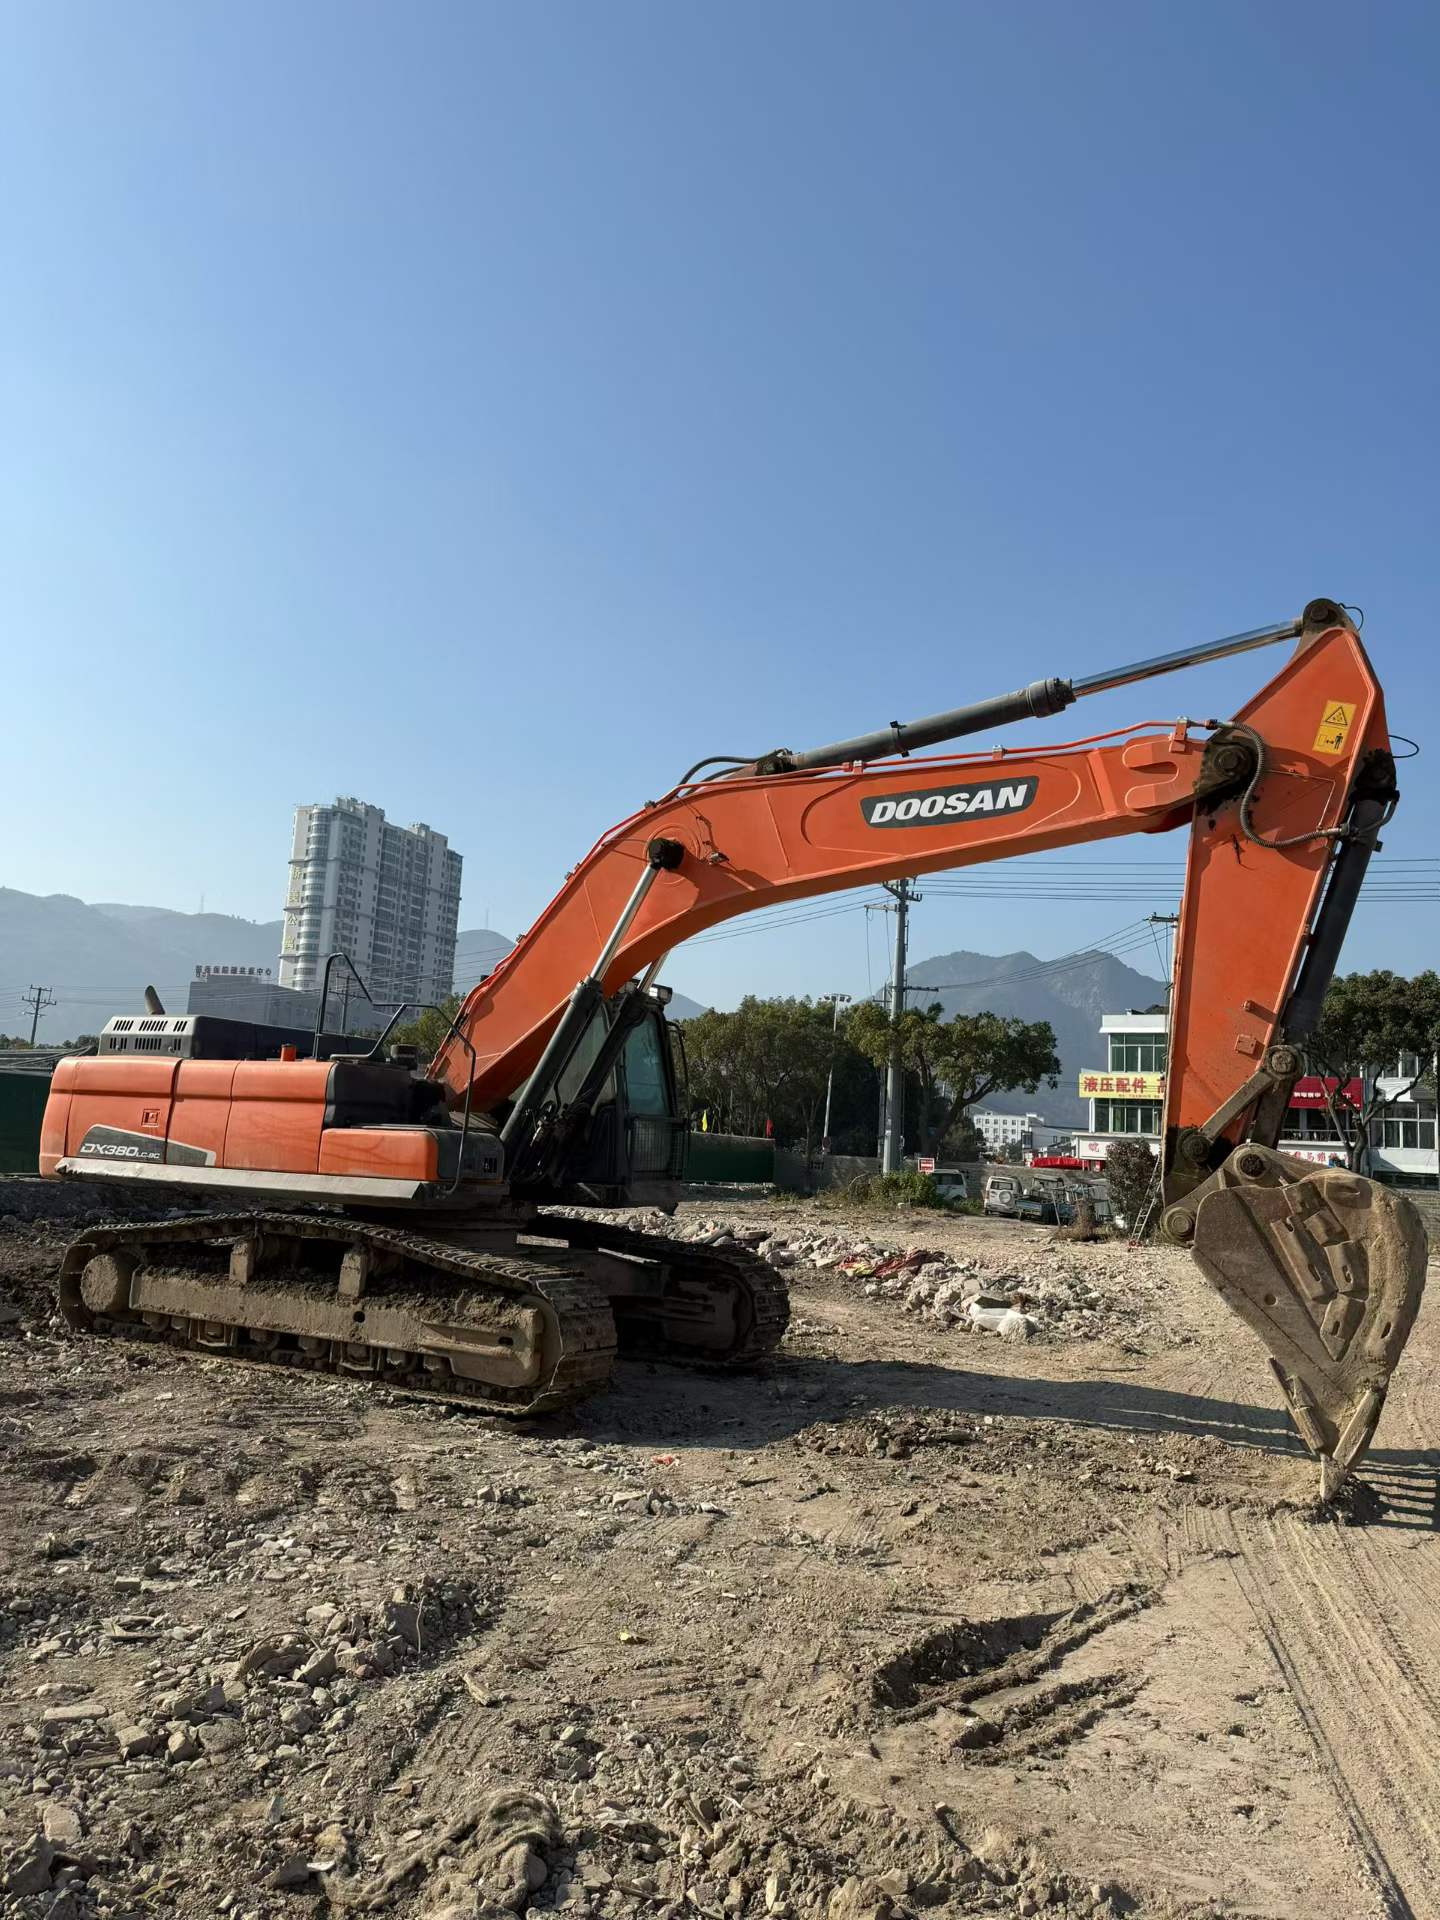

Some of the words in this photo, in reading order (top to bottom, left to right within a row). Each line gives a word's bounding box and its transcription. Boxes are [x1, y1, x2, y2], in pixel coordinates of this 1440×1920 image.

[870, 784, 1028, 824] DOOSAN
[1083, 1076, 1147, 1094] 液压配件
